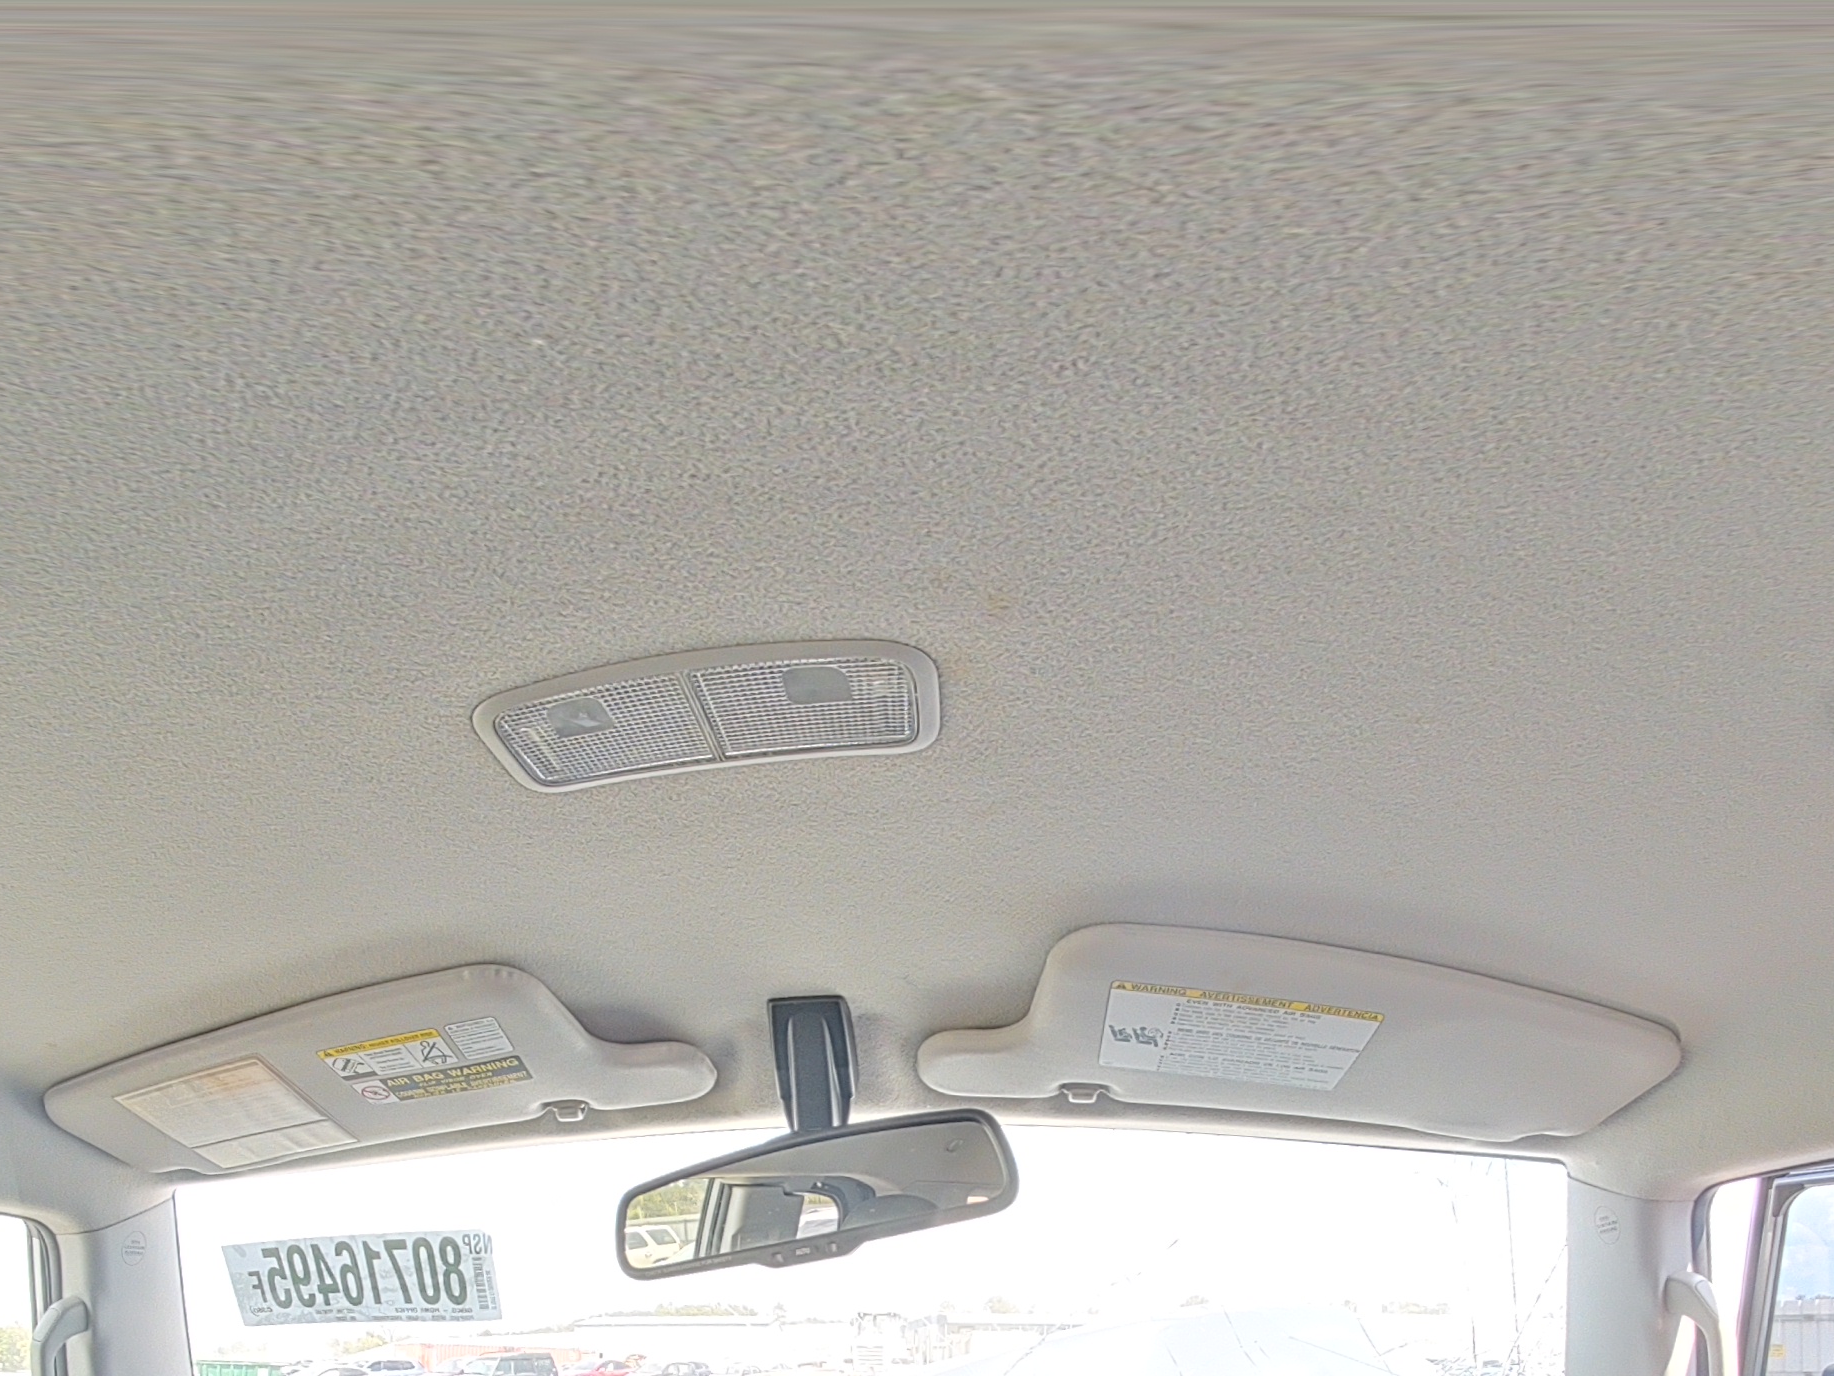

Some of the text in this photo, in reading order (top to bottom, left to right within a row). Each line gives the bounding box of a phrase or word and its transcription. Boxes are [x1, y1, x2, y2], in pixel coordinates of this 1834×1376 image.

[1131, 983, 1187, 995] WARNING
[1304, 1004, 1379, 1020] ADVERTENCIA
[387, 1058, 519, 1087] AIR BAG WARNING
